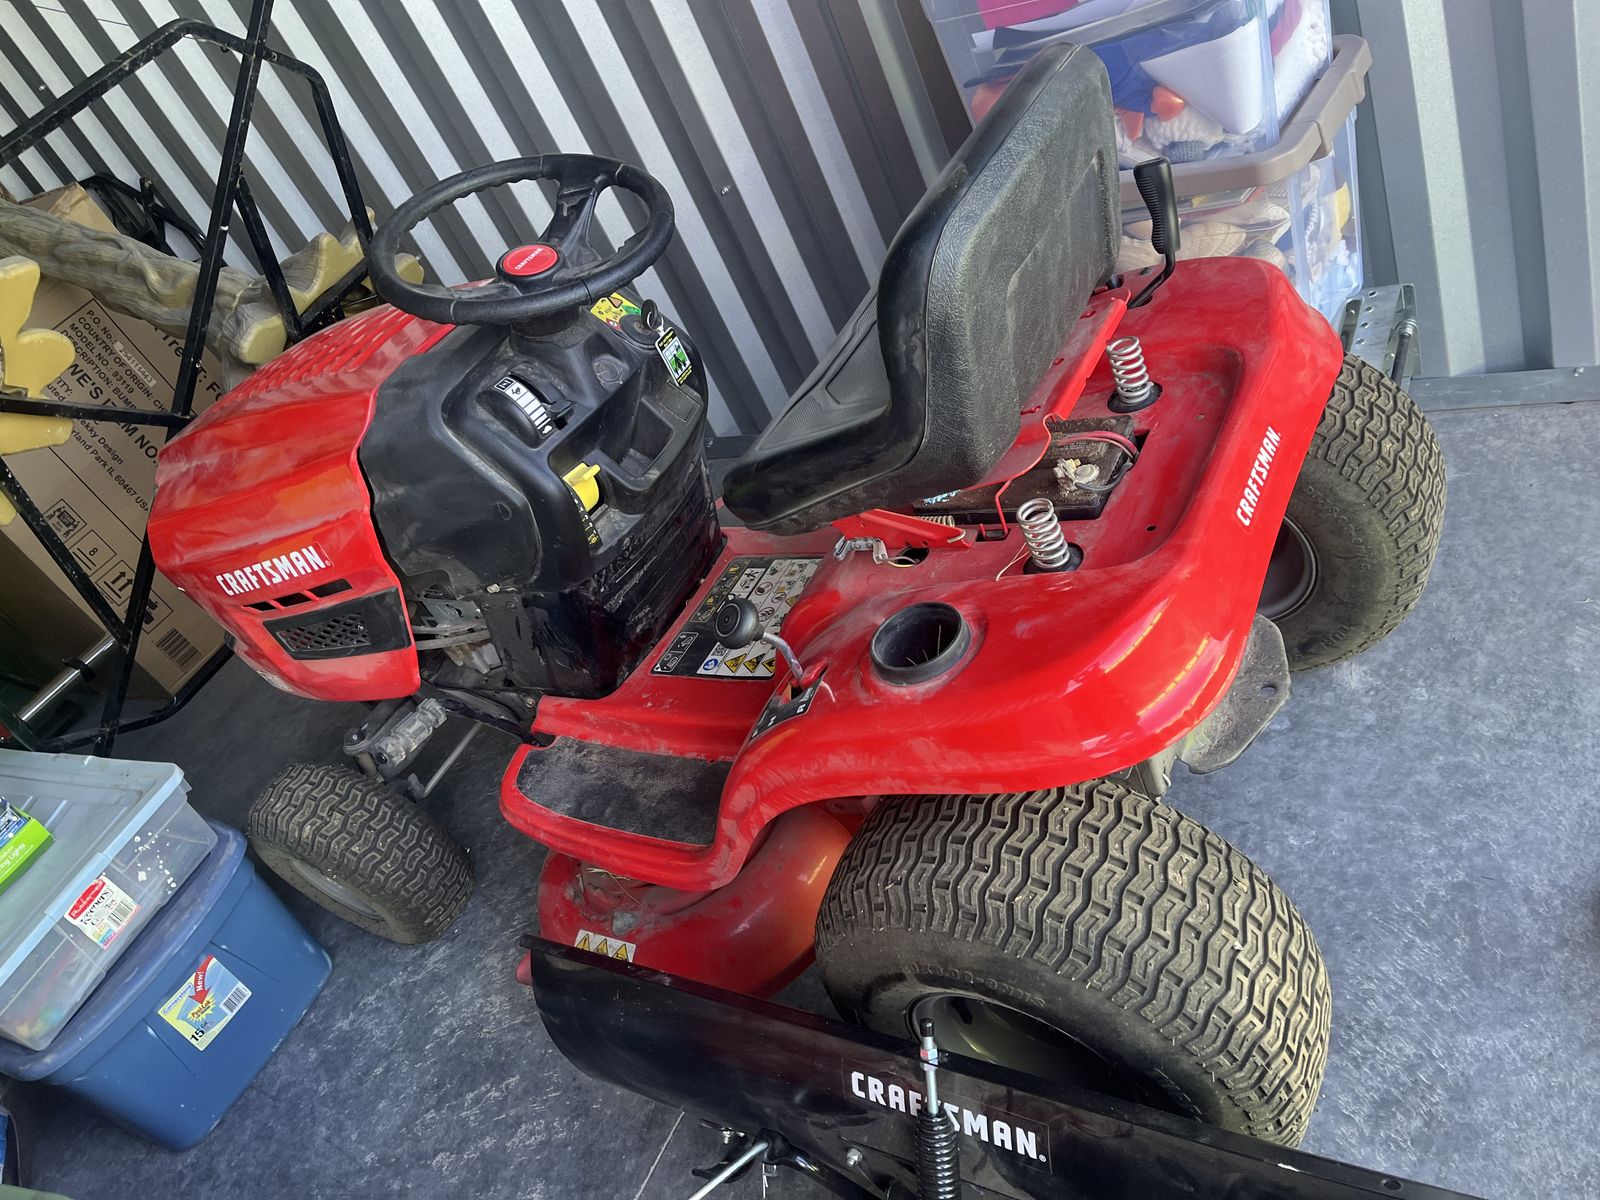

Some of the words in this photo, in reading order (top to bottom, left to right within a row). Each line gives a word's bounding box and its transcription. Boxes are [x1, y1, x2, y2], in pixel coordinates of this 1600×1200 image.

[69, 322, 96, 354] MODEL
[111, 370, 135, 394] 93119
[78, 316, 116, 356] COUNTRY
[113, 356, 127, 369] OF
[124, 368, 154, 400] ORIGIN:
[89, 449, 108, 468] Park
[106, 466, 117, 477] IL
[114, 474, 137, 496] 60467
[97, 437, 123, 465] Design
[1236, 425, 1281, 526] CRAFTSMAN
[215, 545, 327, 596] CRAFTSMAN
[195, 971, 205, 993] New!
[190, 1028, 206, 1042] 15
[851, 1071, 1039, 1161] CRAFSMAN
